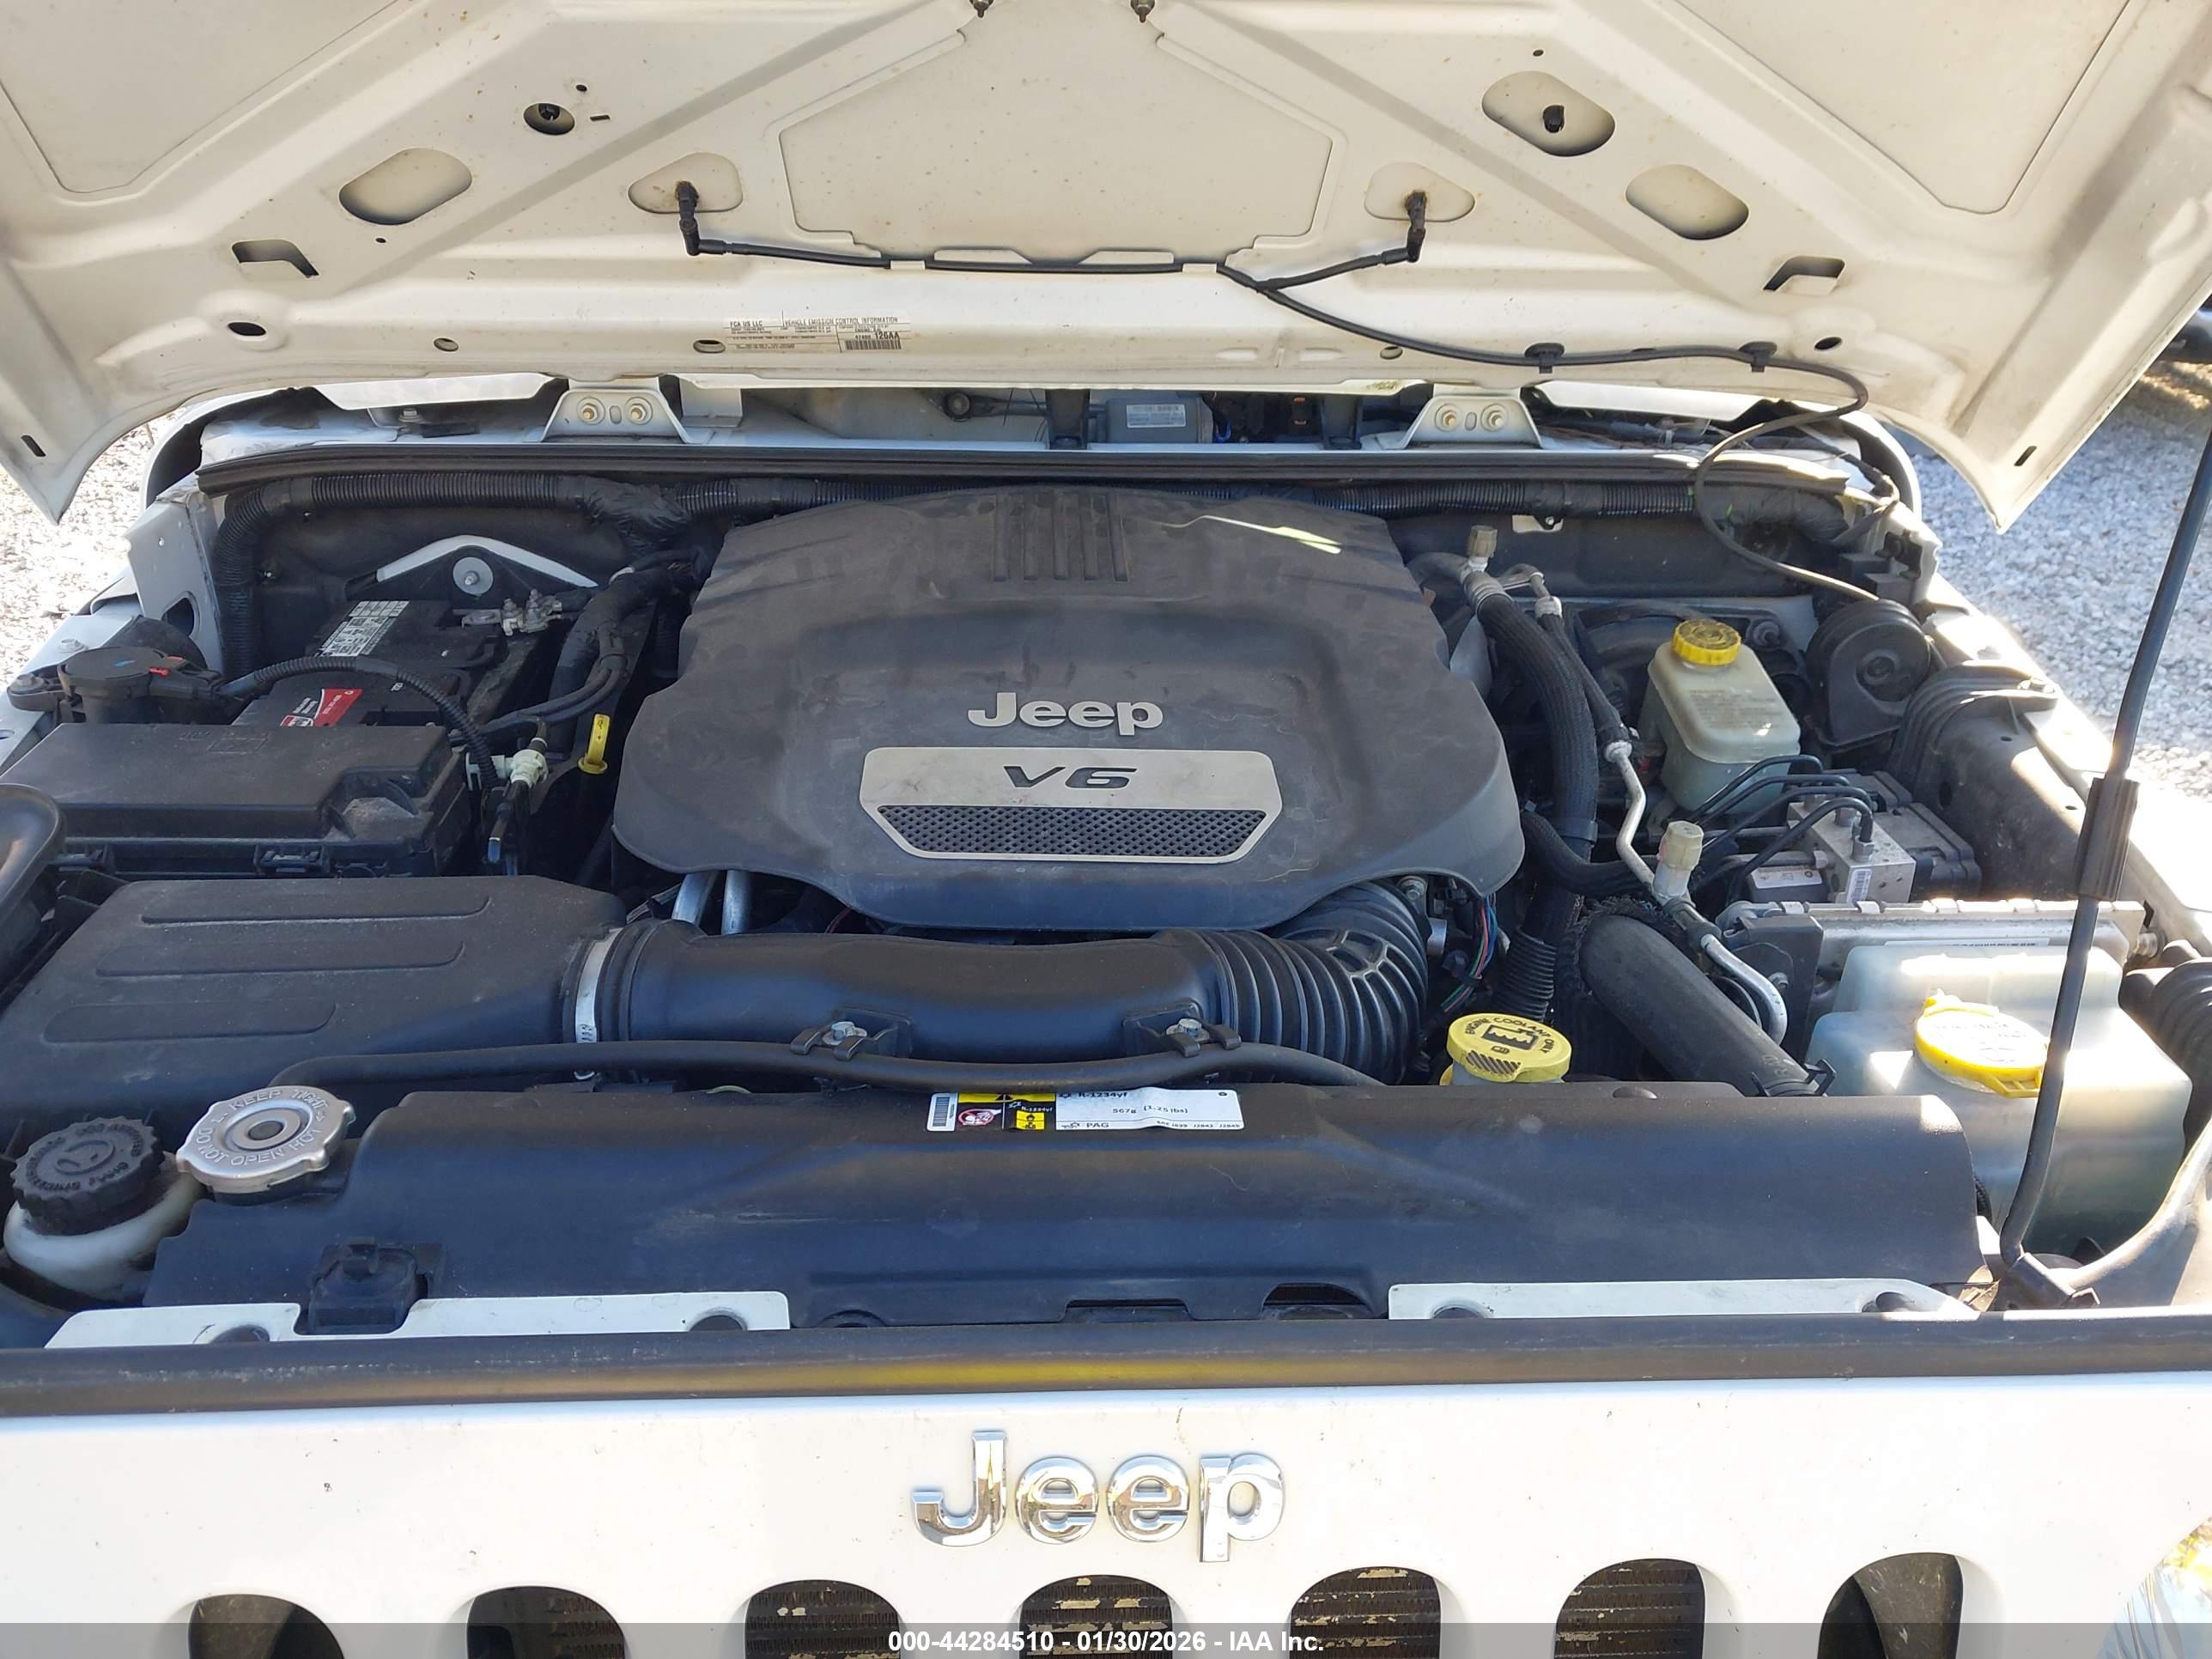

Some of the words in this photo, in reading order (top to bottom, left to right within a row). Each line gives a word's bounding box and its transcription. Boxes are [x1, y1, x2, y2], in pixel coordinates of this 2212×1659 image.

[968, 692, 1164, 736] Jeep
[1003, 765, 1138, 789] V6
[1464, 1018, 1492, 1036] ENGINE
[1493, 1017, 1552, 1040] COOLANT
[229, 1089, 283, 1111] KEEP
[291, 1089, 330, 1109] TIGHT
[1143, 1105, 1169, 1114] (1.25
[196, 1127, 214, 1144] DO
[291, 1128, 323, 1152] HOT
[198, 1144, 229, 1163] NOT
[230, 1149, 285, 1166] OPEN
[912, 1429, 1285, 1563] Jeep
